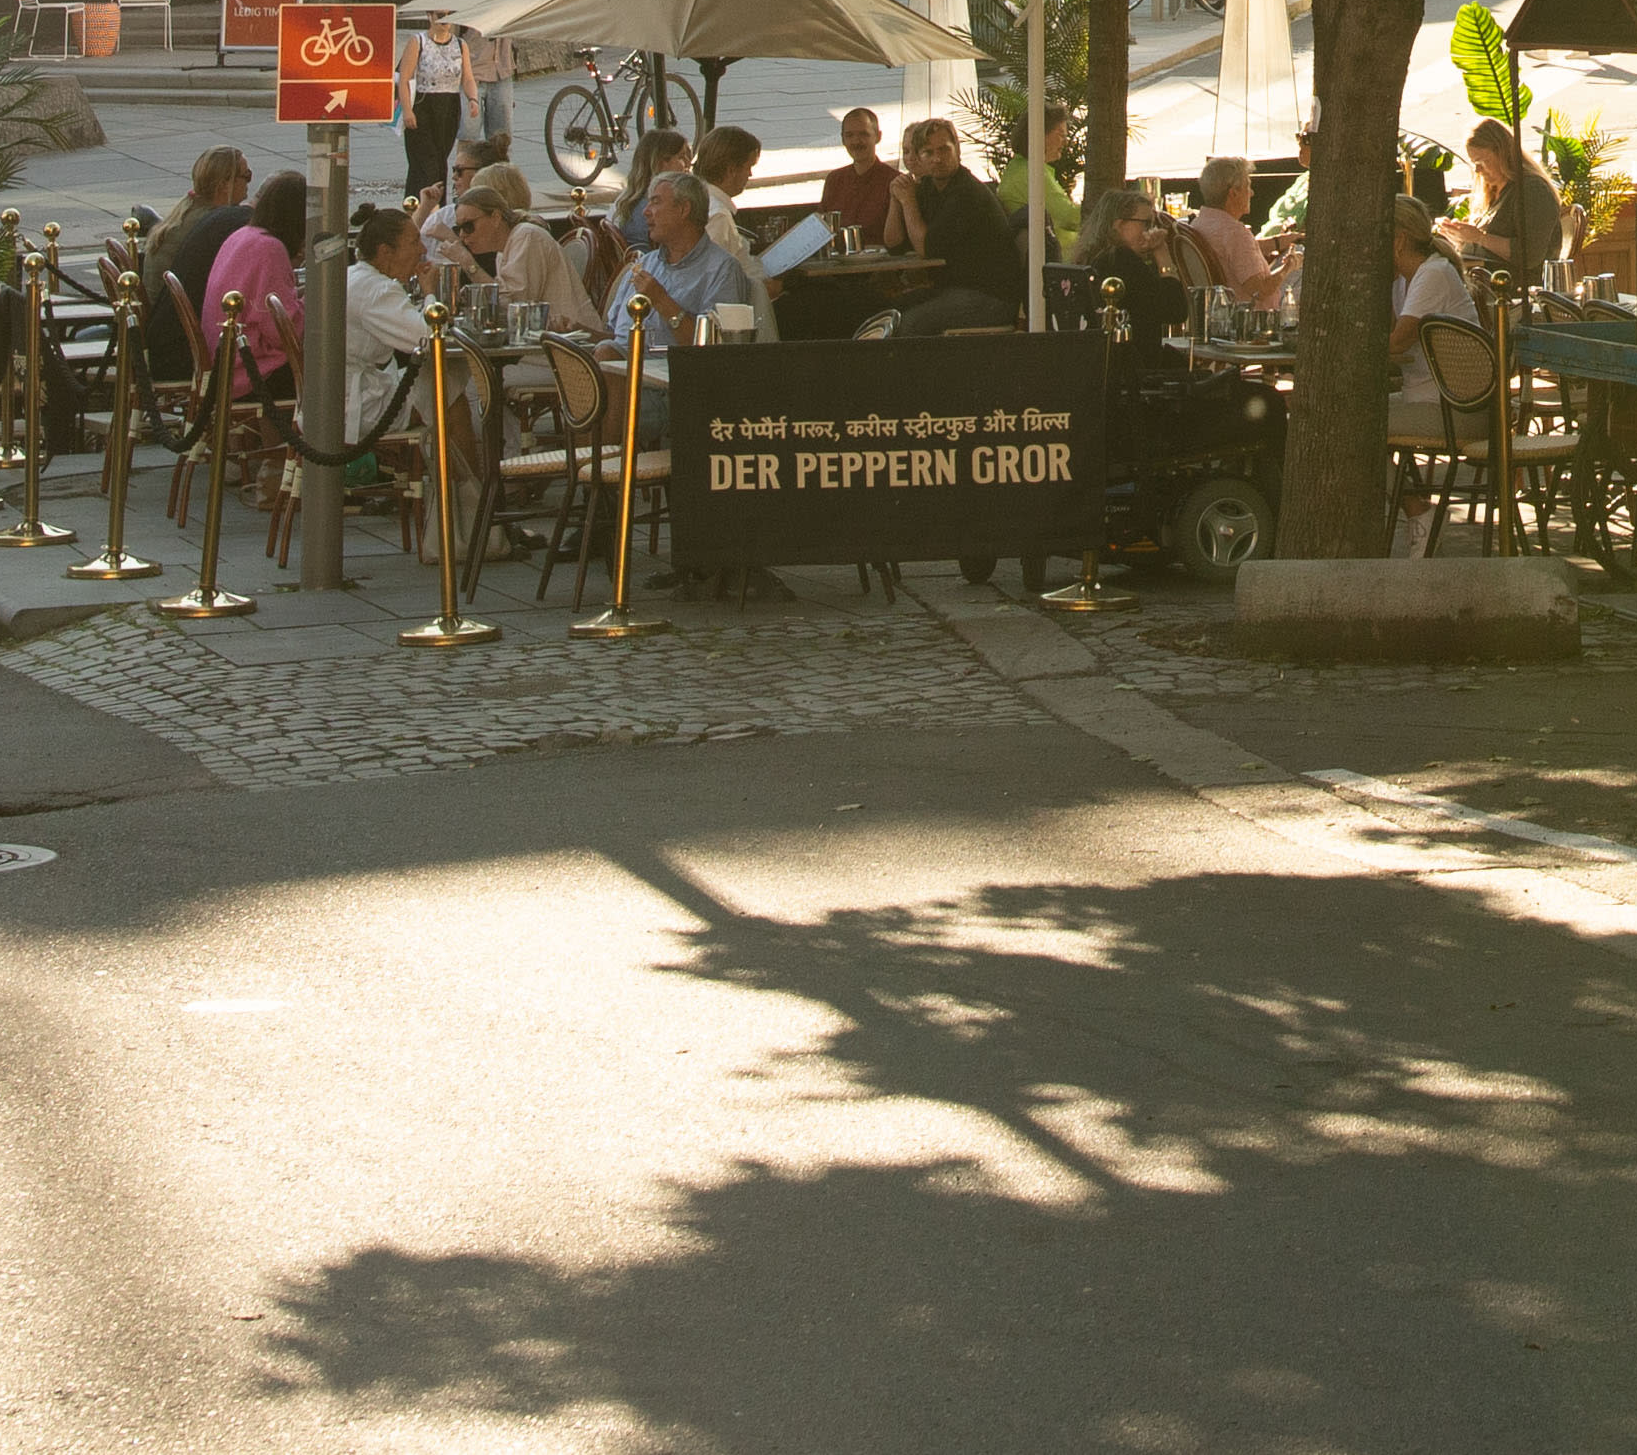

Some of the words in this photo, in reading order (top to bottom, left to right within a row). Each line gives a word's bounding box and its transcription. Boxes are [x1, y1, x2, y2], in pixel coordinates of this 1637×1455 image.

[234, 6, 261, 17] LEDIG
[709, 453, 781, 491] DER
[795, 448, 957, 489] PEPPERN
[971, 443, 1073, 485] GROR
